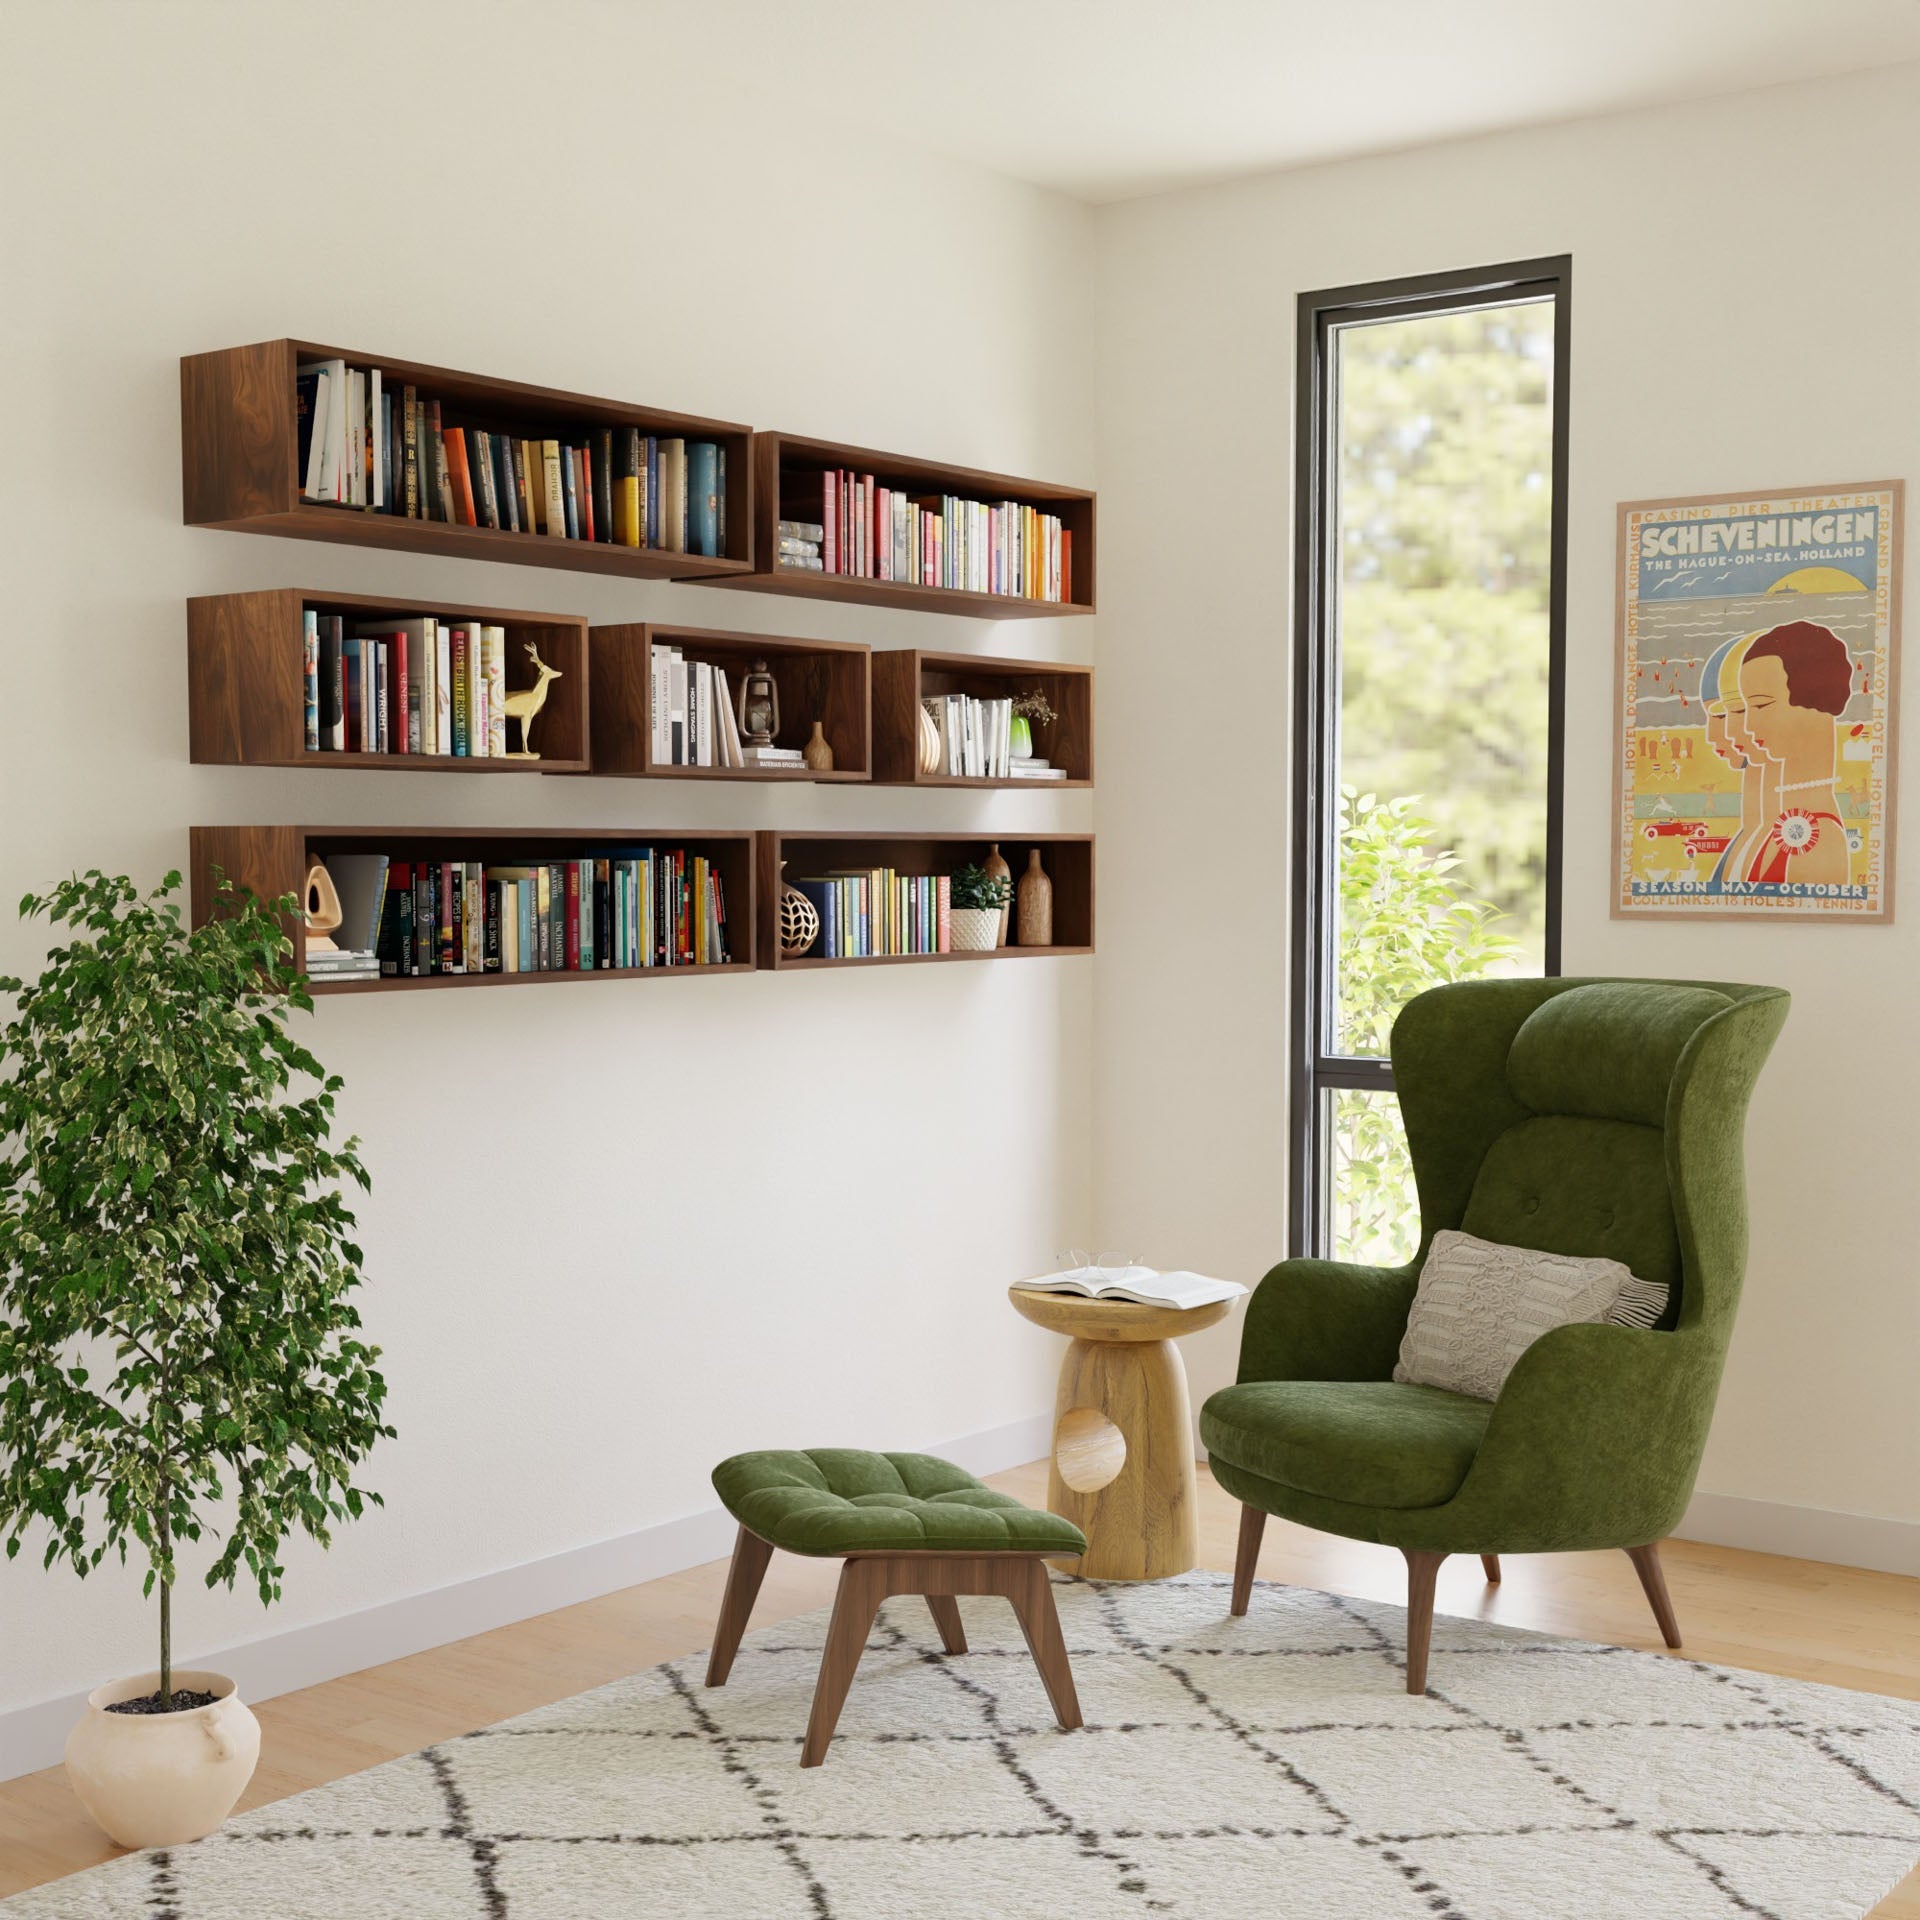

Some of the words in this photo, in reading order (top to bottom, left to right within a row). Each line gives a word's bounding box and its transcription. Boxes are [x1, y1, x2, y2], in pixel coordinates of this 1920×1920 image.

[1644, 508, 1712, 523] CASINO
[1729, 503, 1770, 517] PIER
[1790, 495, 1876, 513] THEATER
[1629, 524, 1640, 590] KURHAUS
[1641, 511, 1875, 558] SCHEVENINGEN
[1878, 508, 1890, 568] GRAND
[1645, 559, 1672, 571] THE
[1627, 597, 1639, 636] HOTEL
[1876, 575, 1888, 627] HOTEL
[456, 637, 464, 663] ELVIS
[1874, 647, 1887, 700] SAVOY
[400, 672, 408, 714] GENESIS
[456, 669, 465, 697] BIRTH
[378, 688, 387, 732] WRIGHT
[456, 700, 465, 724] ROCK
[1625, 722, 1636, 769] HOTEL
[1872, 709, 1885, 763] HOTEL
[1624, 785, 1635, 834] HOTEL
[1870, 779, 1883, 830] HOTEL
[1623, 839, 1634, 892] PALACE
[1638, 881, 1707, 893] SEASON
[1721, 881, 1759, 894] MAY
[1779, 882, 1863, 897] OCTOBER
[1867, 839, 1881, 895] RAUCH
[1814, 898, 1863, 911] TENNIS
[555, 921, 563, 968] ENCHANTRESS
